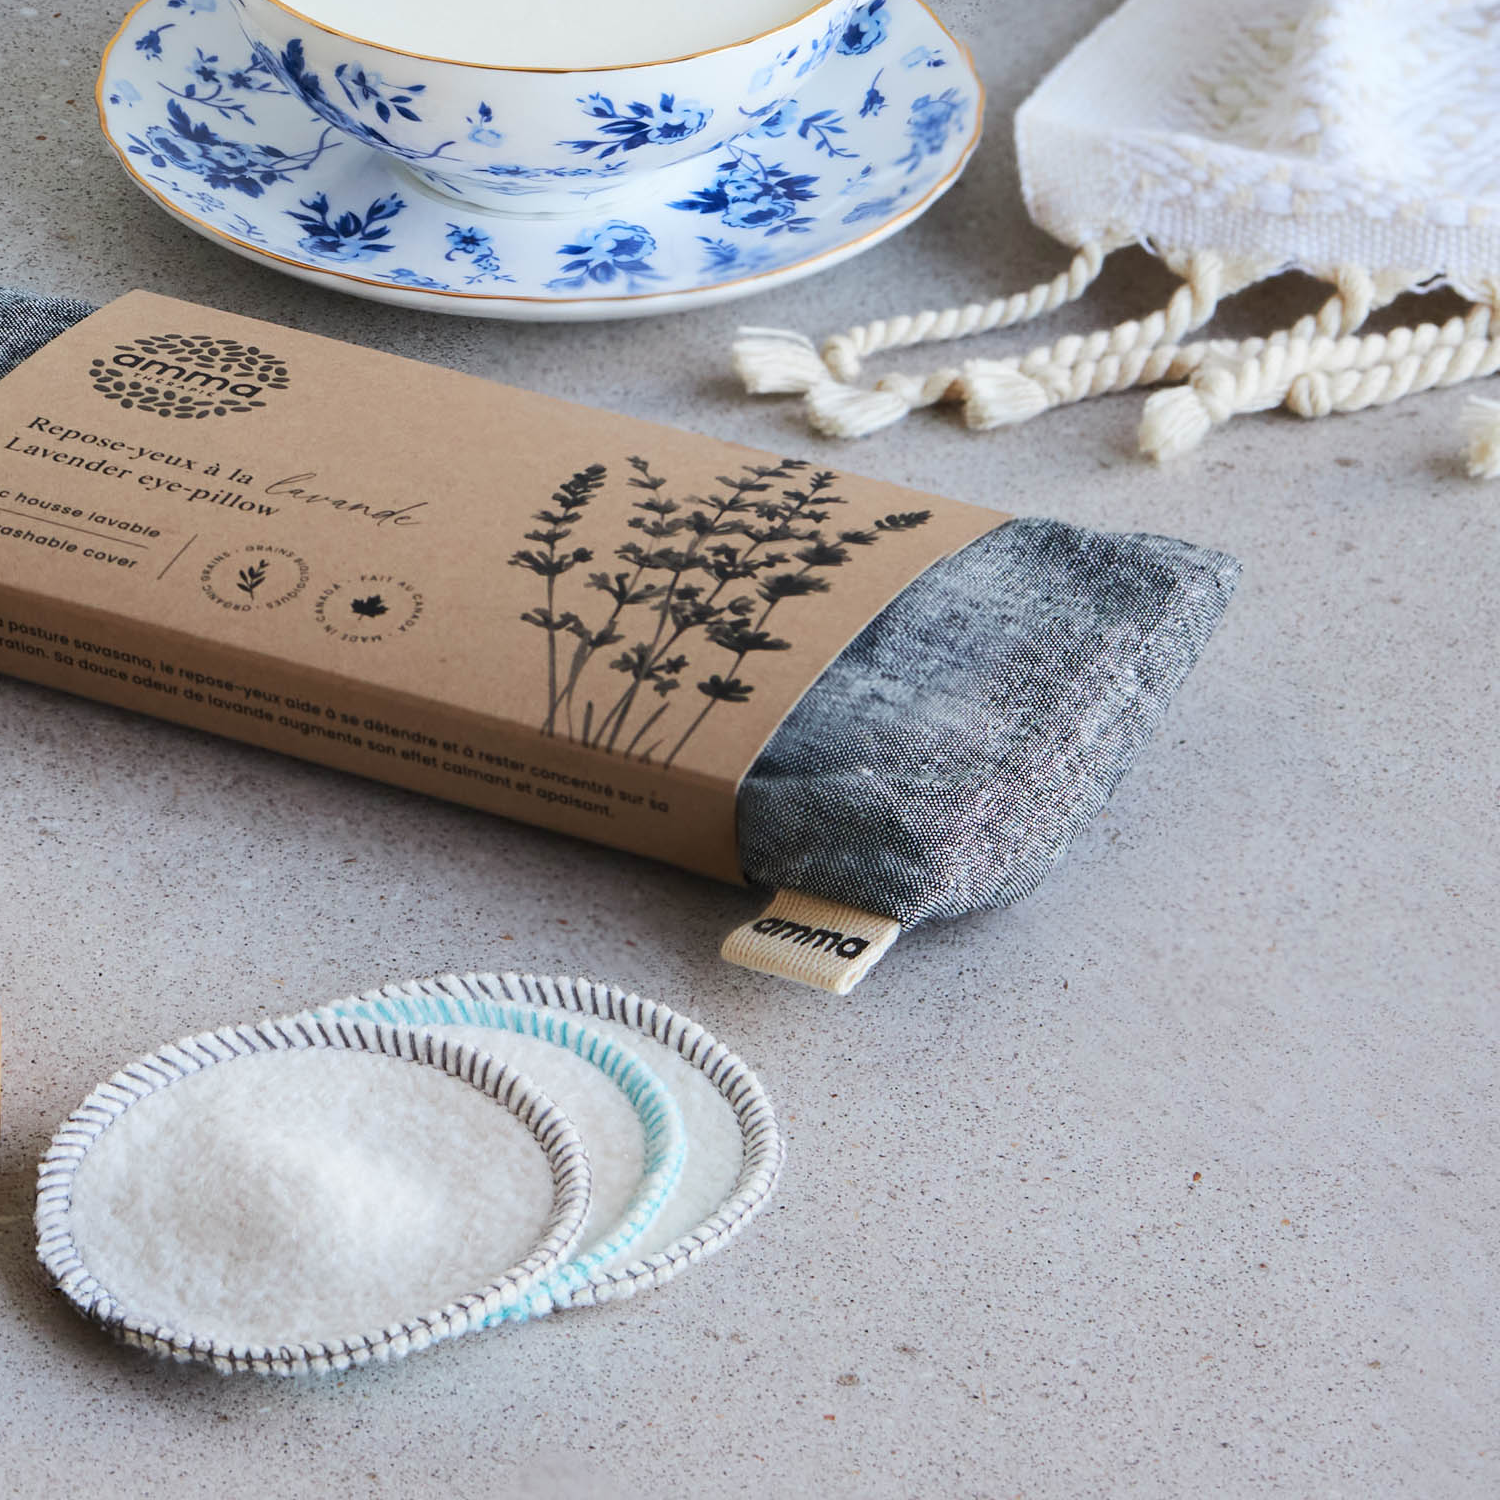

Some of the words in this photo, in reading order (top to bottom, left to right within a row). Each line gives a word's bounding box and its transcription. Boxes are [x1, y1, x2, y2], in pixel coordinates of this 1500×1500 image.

[112, 353, 263, 399] amma
[4, 436, 134, 480] Lavender
[138, 471, 280, 517] eye-pillow
[27, 416, 198, 471] Repose-yeux
[203, 463, 220, 477] à
[228, 468, 254, 485] la
[265, 473, 428, 527] lavande
[14, 492, 84, 518] housse
[88, 512, 161, 538] lavable
[83, 548, 139, 569] cover
[8, 619, 69, 646] posture
[73, 637, 156, 673] savasana,
[160, 660, 175, 676] le
[179, 668, 281, 705] repose-yeux
[285, 697, 321, 717] aide
[326, 707, 337, 721] à
[340, 712, 360, 727] se
[363, 717, 438, 750] détendre
[441, 740, 459, 756] et
[462, 743, 475, 758] à
[479, 750, 526, 772] rester
[530, 764, 614, 798] concentré
[618, 788, 645, 807] sur
[649, 794, 670, 814] sa
[54, 651, 75, 667] Sa
[78, 658, 128, 682] douce
[132, 672, 178, 697] odeur
[183, 686, 203, 703] de
[208, 692, 274, 722] lavande
[278, 714, 363, 747] augmente
[367, 738, 397, 756] son
[401, 747, 438, 769] effet
[442, 759, 512, 789] calmant
[515, 779, 534, 794] et
[536, 786, 615, 819] apaisant.
[752, 917, 871, 960] amma
